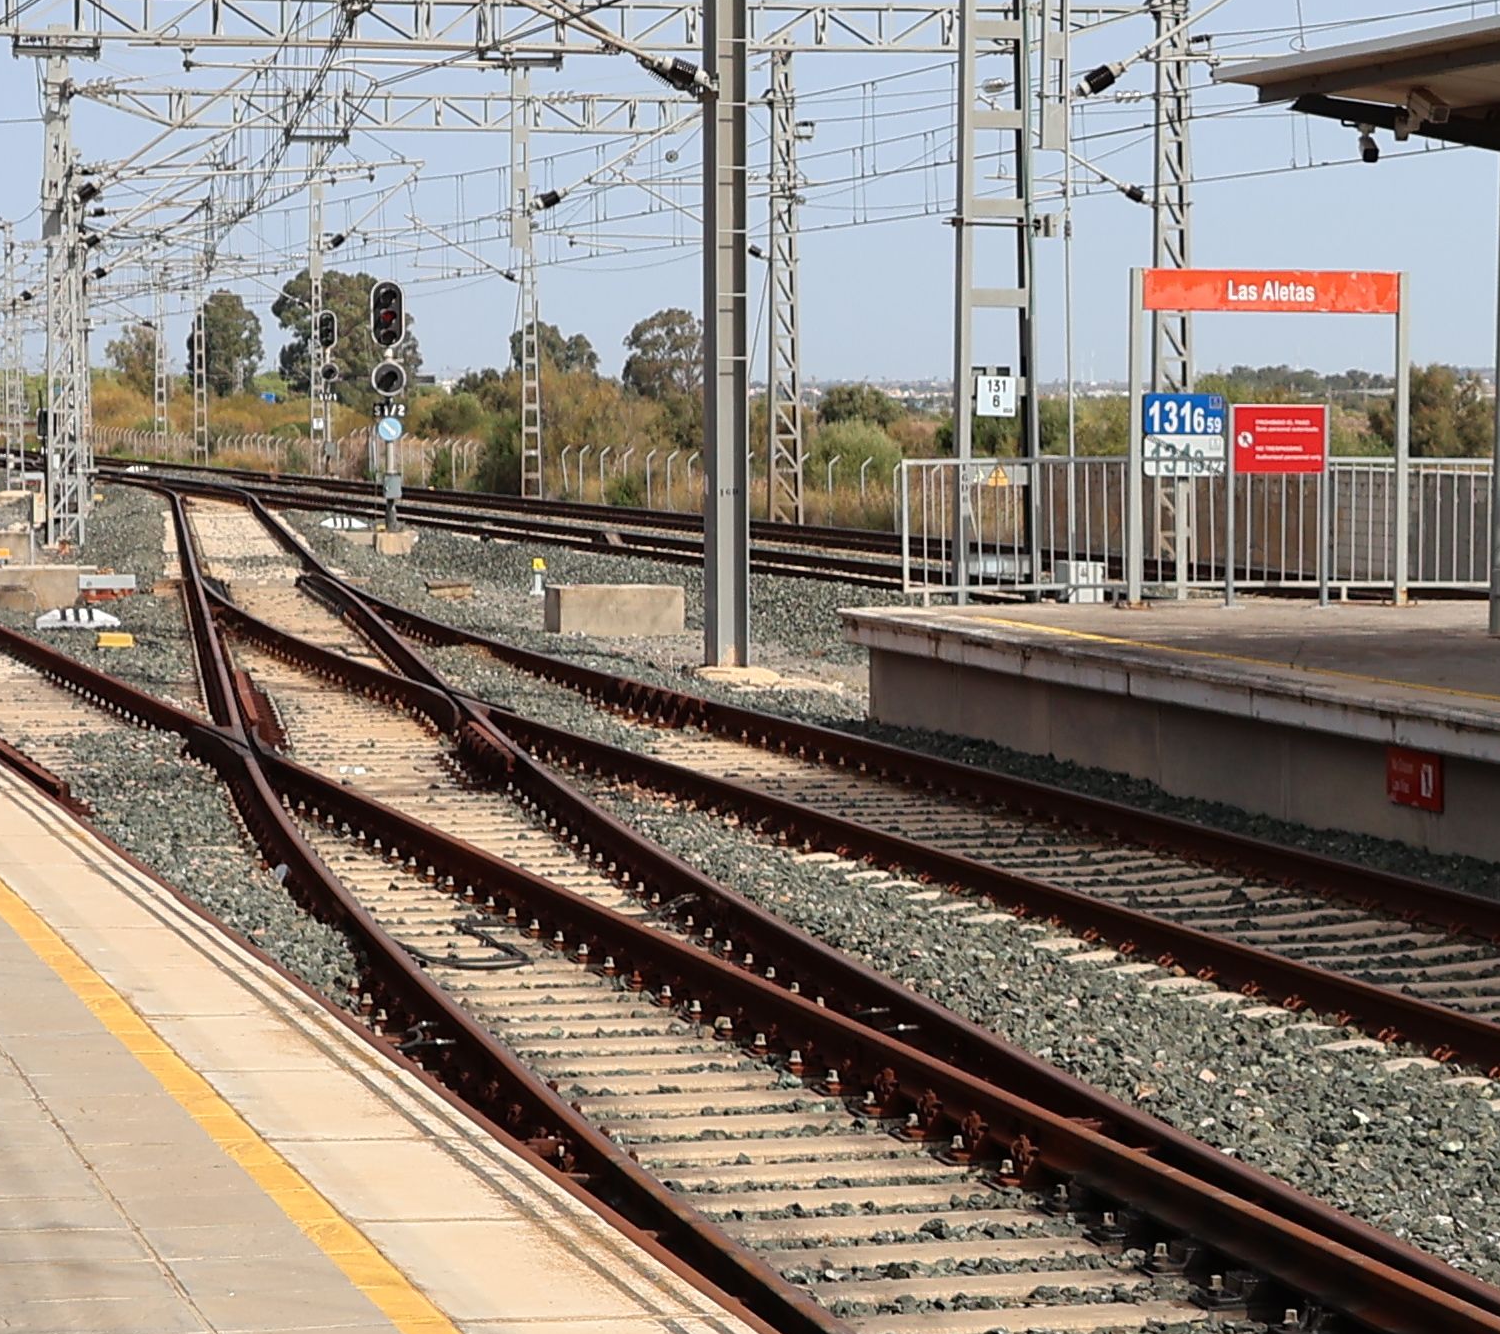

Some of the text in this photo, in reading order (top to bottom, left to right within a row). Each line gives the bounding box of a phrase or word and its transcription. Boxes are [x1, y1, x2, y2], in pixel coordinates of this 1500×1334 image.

[1227, 280, 1316, 302] Las Aletas
[988, 379, 1006, 393] 131
[992, 394, 1001, 408] 6
